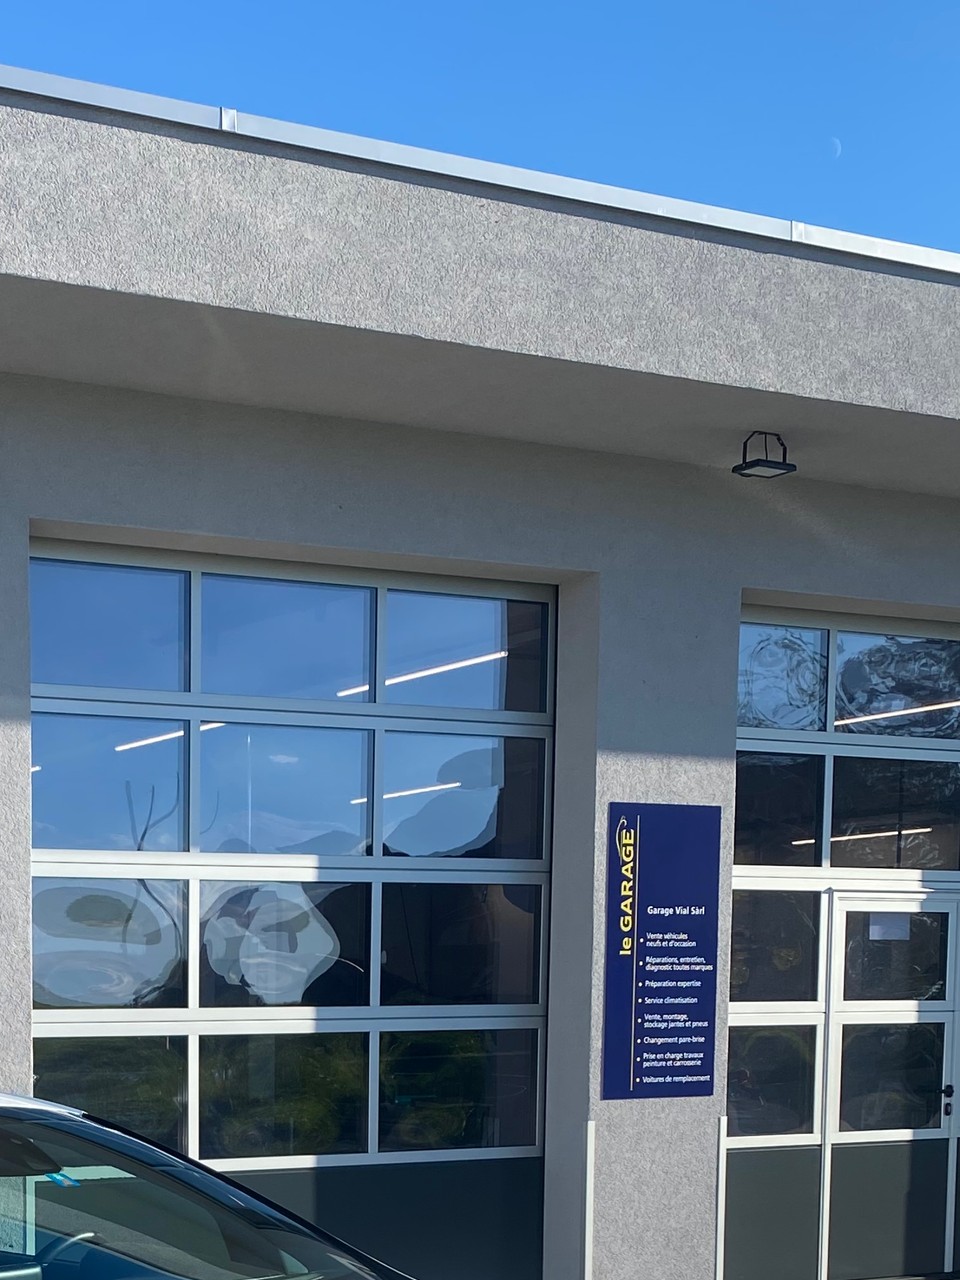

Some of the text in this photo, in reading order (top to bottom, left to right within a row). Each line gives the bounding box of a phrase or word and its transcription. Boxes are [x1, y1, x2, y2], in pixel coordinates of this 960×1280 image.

[619, 828, 635, 955] le GARAGE
[647, 906, 674, 916] Garage
[675, 906, 690, 915] Vial
[646, 932, 663, 940] Vente
[644, 980, 702, 988] Préparation expertise
[643, 1037, 678, 1045] Changement
[643, 1052, 656, 1060] Prise
[664, 1052, 683, 1061] charge
[642, 1060, 666, 1069] peinture
[664, 1075, 673, 1083] de
